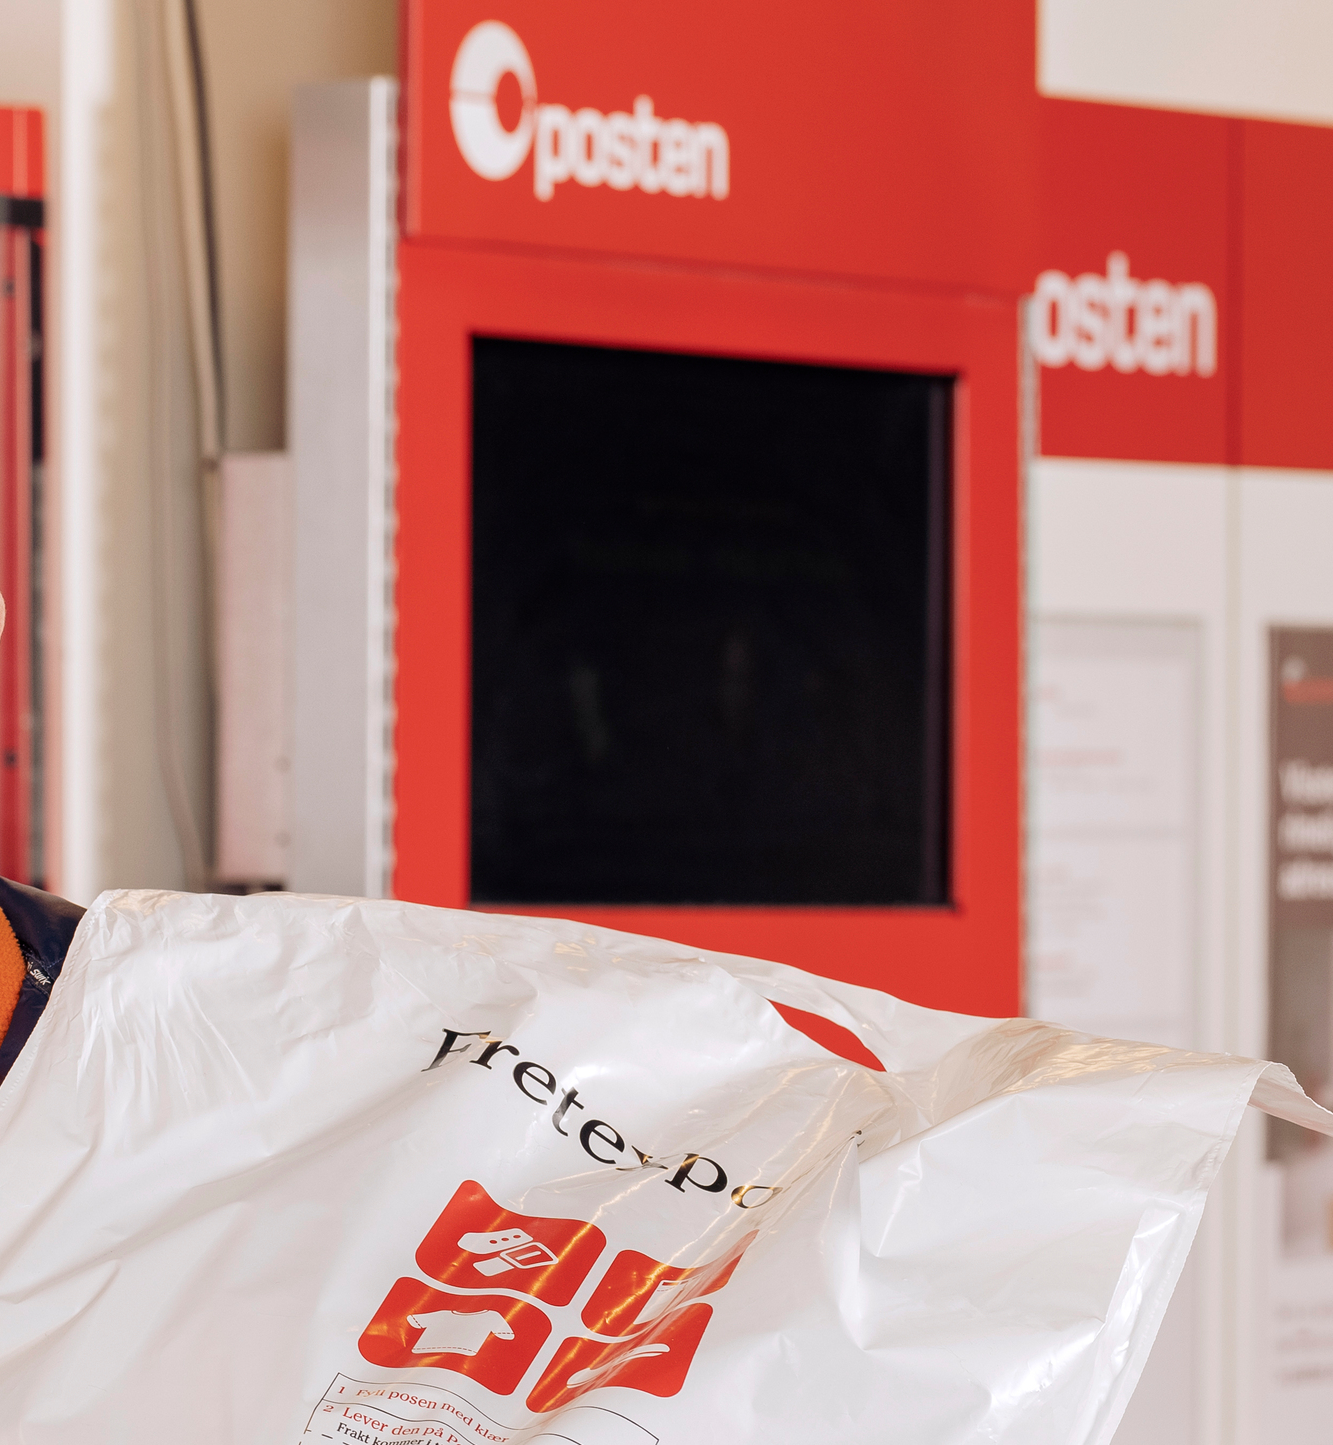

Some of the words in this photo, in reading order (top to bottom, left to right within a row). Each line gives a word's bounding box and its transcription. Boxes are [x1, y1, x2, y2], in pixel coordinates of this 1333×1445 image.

[534, 94, 731, 202] posten
[1032, 250, 1218, 378] osten
[322, 1405, 335, 1413] 2
[342, 1406, 389, 1432] Lever
[391, 1424, 420, 1436] den
[422, 1426, 444, 1438] på
[336, 1421, 370, 1444] Frakt
[387, 1390, 437, 1410] posen
[440, 1402, 474, 1426] med
[474, 1423, 511, 1444] klær
